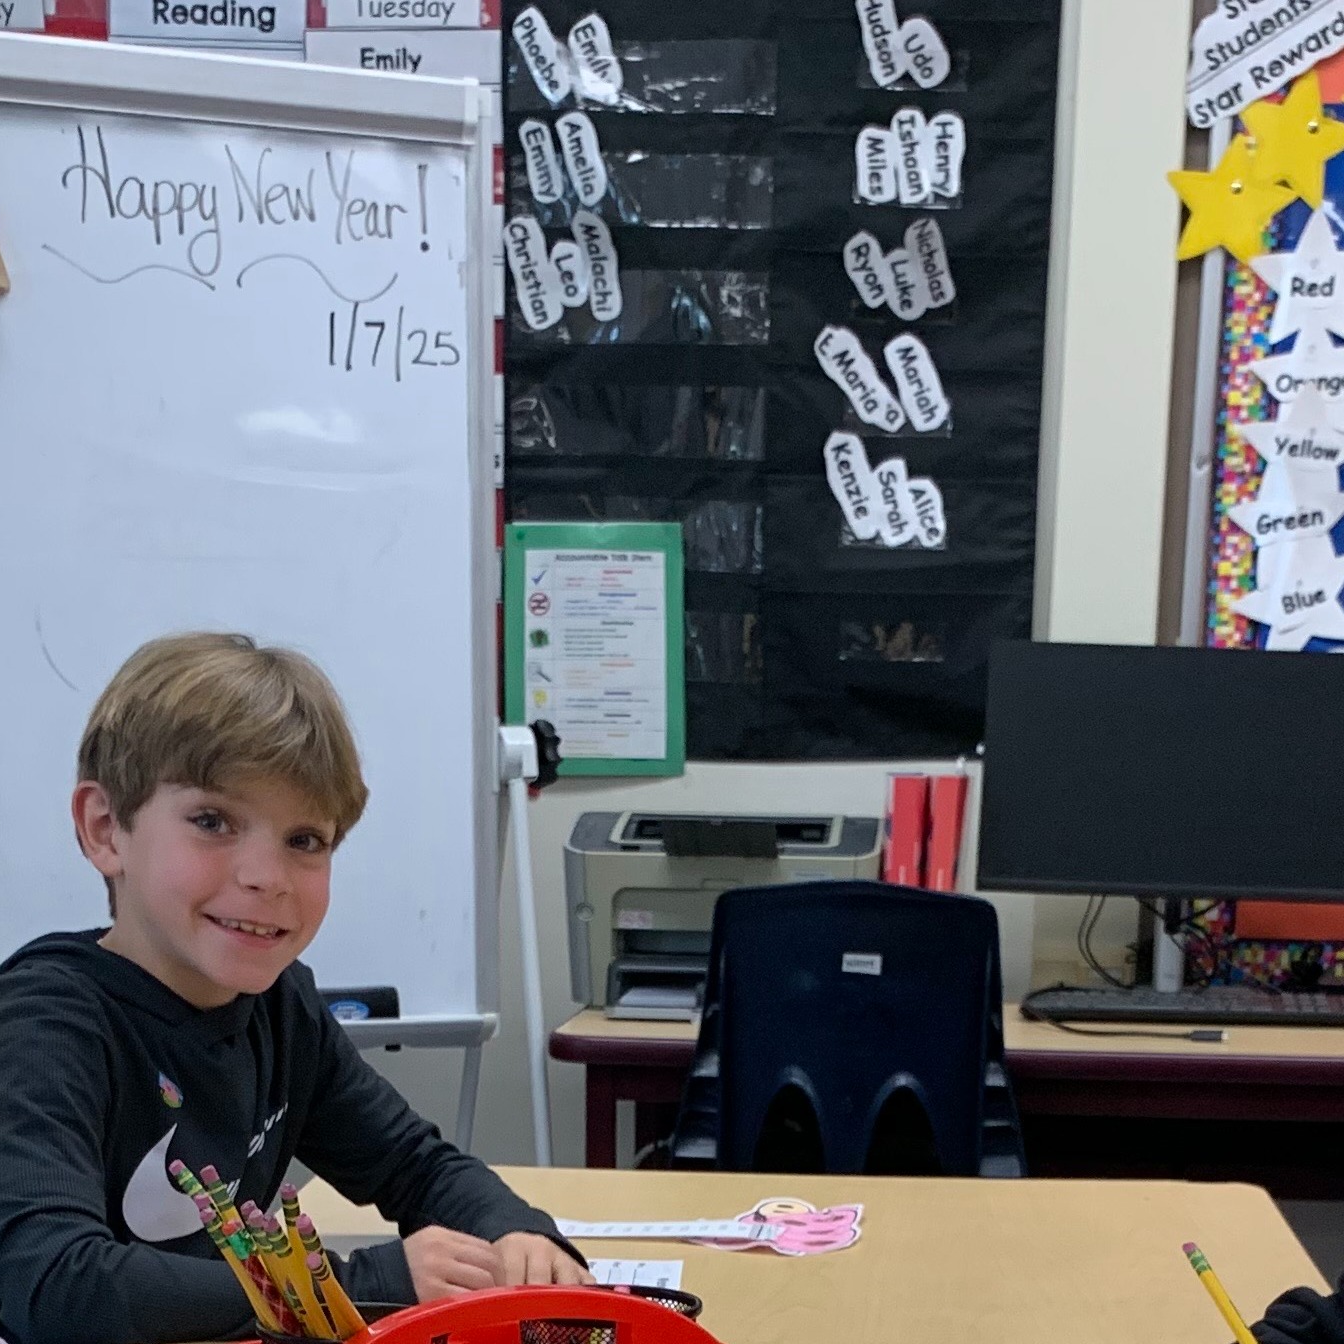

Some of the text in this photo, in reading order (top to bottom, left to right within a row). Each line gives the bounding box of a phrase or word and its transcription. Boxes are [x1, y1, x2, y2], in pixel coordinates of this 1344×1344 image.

[152, 0, 277, 33] Reading
[1205, 0, 1312, 71] Students
[360, 47, 421, 72] Emily
[514, 15, 561, 94] Phoebe
[903, 33, 935, 80] Udo
[1194, 81, 1243, 125] Star
[525, 127, 558, 199] Emmy
[564, 121, 597, 198] Amelia
[866, 136, 888, 197] Miles
[898, 114, 925, 197] Ishaan
[931, 121, 956, 194] Henry
[62, 125, 222, 277] Happy
[225, 143, 317, 226] New
[509, 223, 550, 325] Christian
[555, 252, 579, 299] Leo
[578, 222, 614, 313] Malachi
[890, 259, 916, 312] Luke
[913, 219, 947, 303] Nicholas
[1290, 275, 1337, 298] Red
[328, 300, 462, 383] 1/7/25
[832, 349, 879, 415] Maria
[895, 345, 940, 423] Mariah
[831, 441, 871, 521] Kenzie
[1273, 436, 1340, 462] Yellow
[878, 470, 910, 537] Sarah
[907, 487, 941, 542] Alice
[1256, 509, 1326, 535] Green
[1280, 588, 1328, 615] Blue
